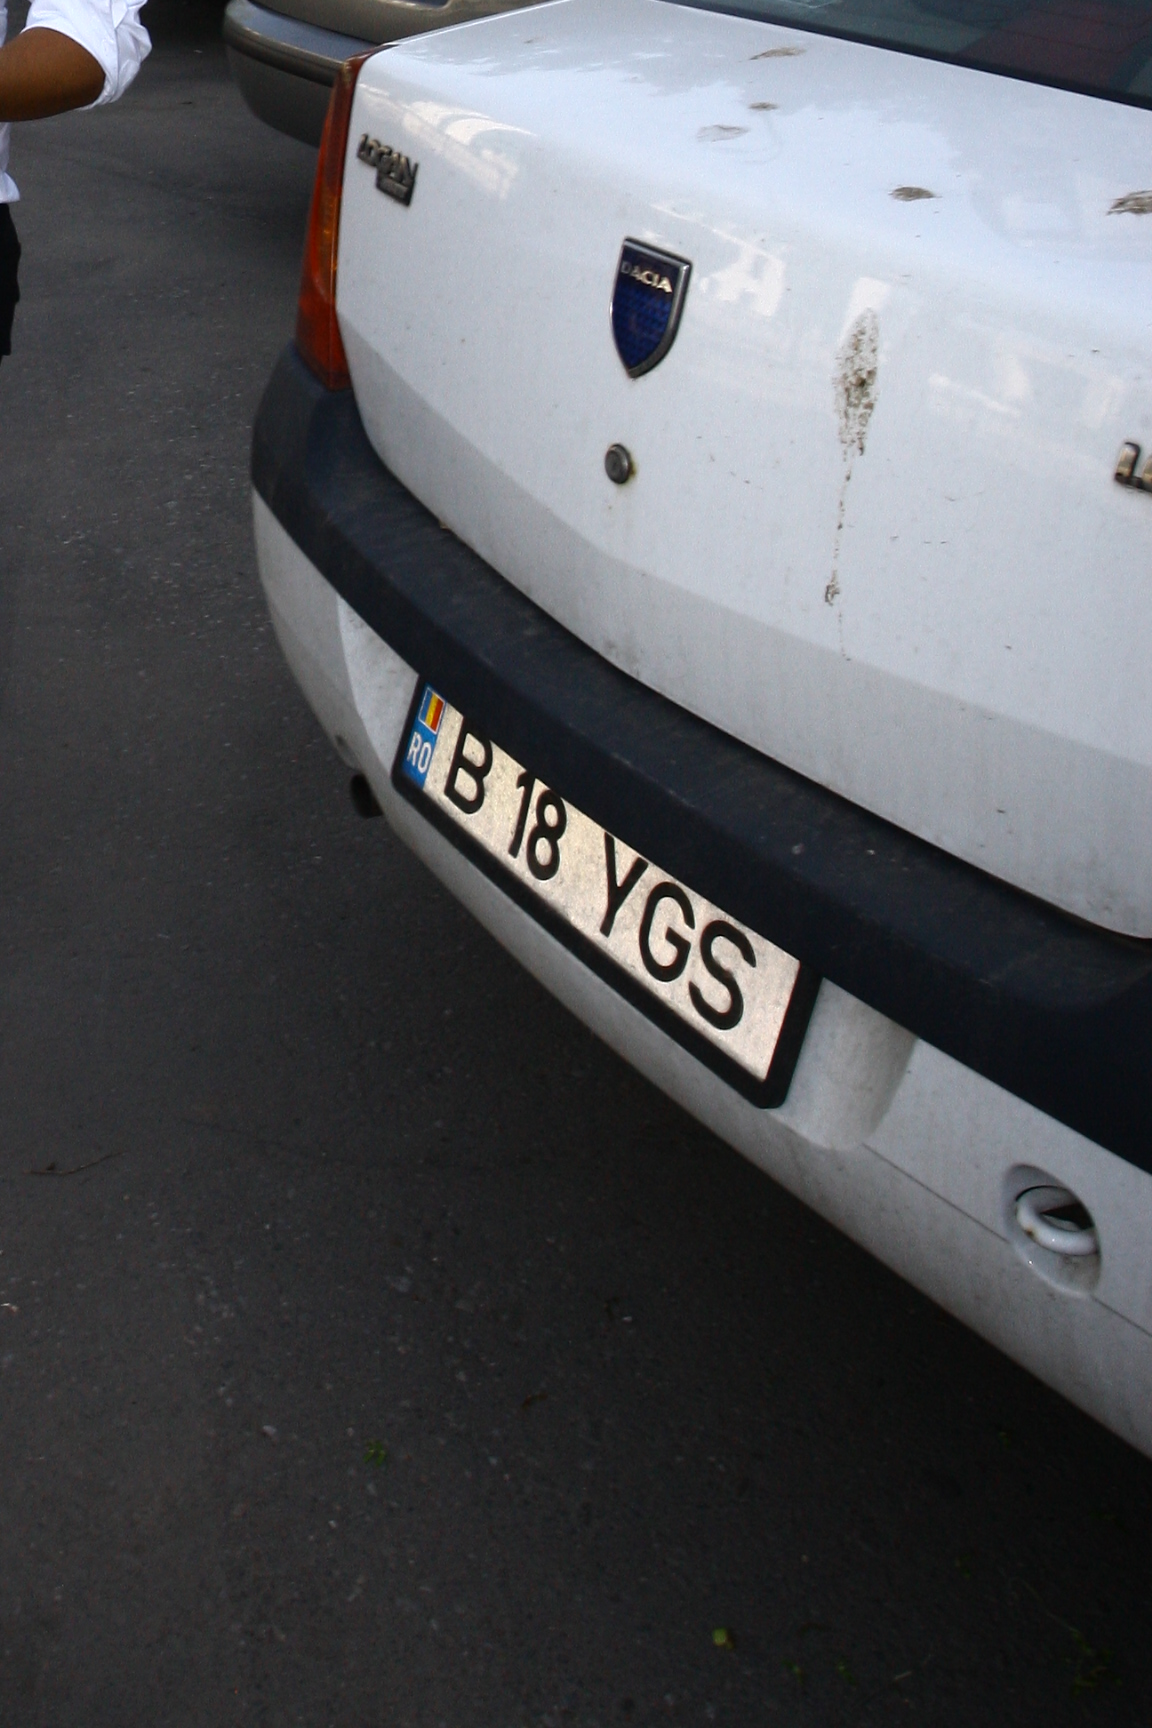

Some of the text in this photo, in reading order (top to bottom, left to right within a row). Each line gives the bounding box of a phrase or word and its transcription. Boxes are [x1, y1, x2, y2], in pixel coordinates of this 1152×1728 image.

[357, 133, 419, 186] LOGAN
[621, 261, 673, 293] DACIA
[407, 731, 432, 773] RO
[444, 717, 756, 1031] B 18 YGS
